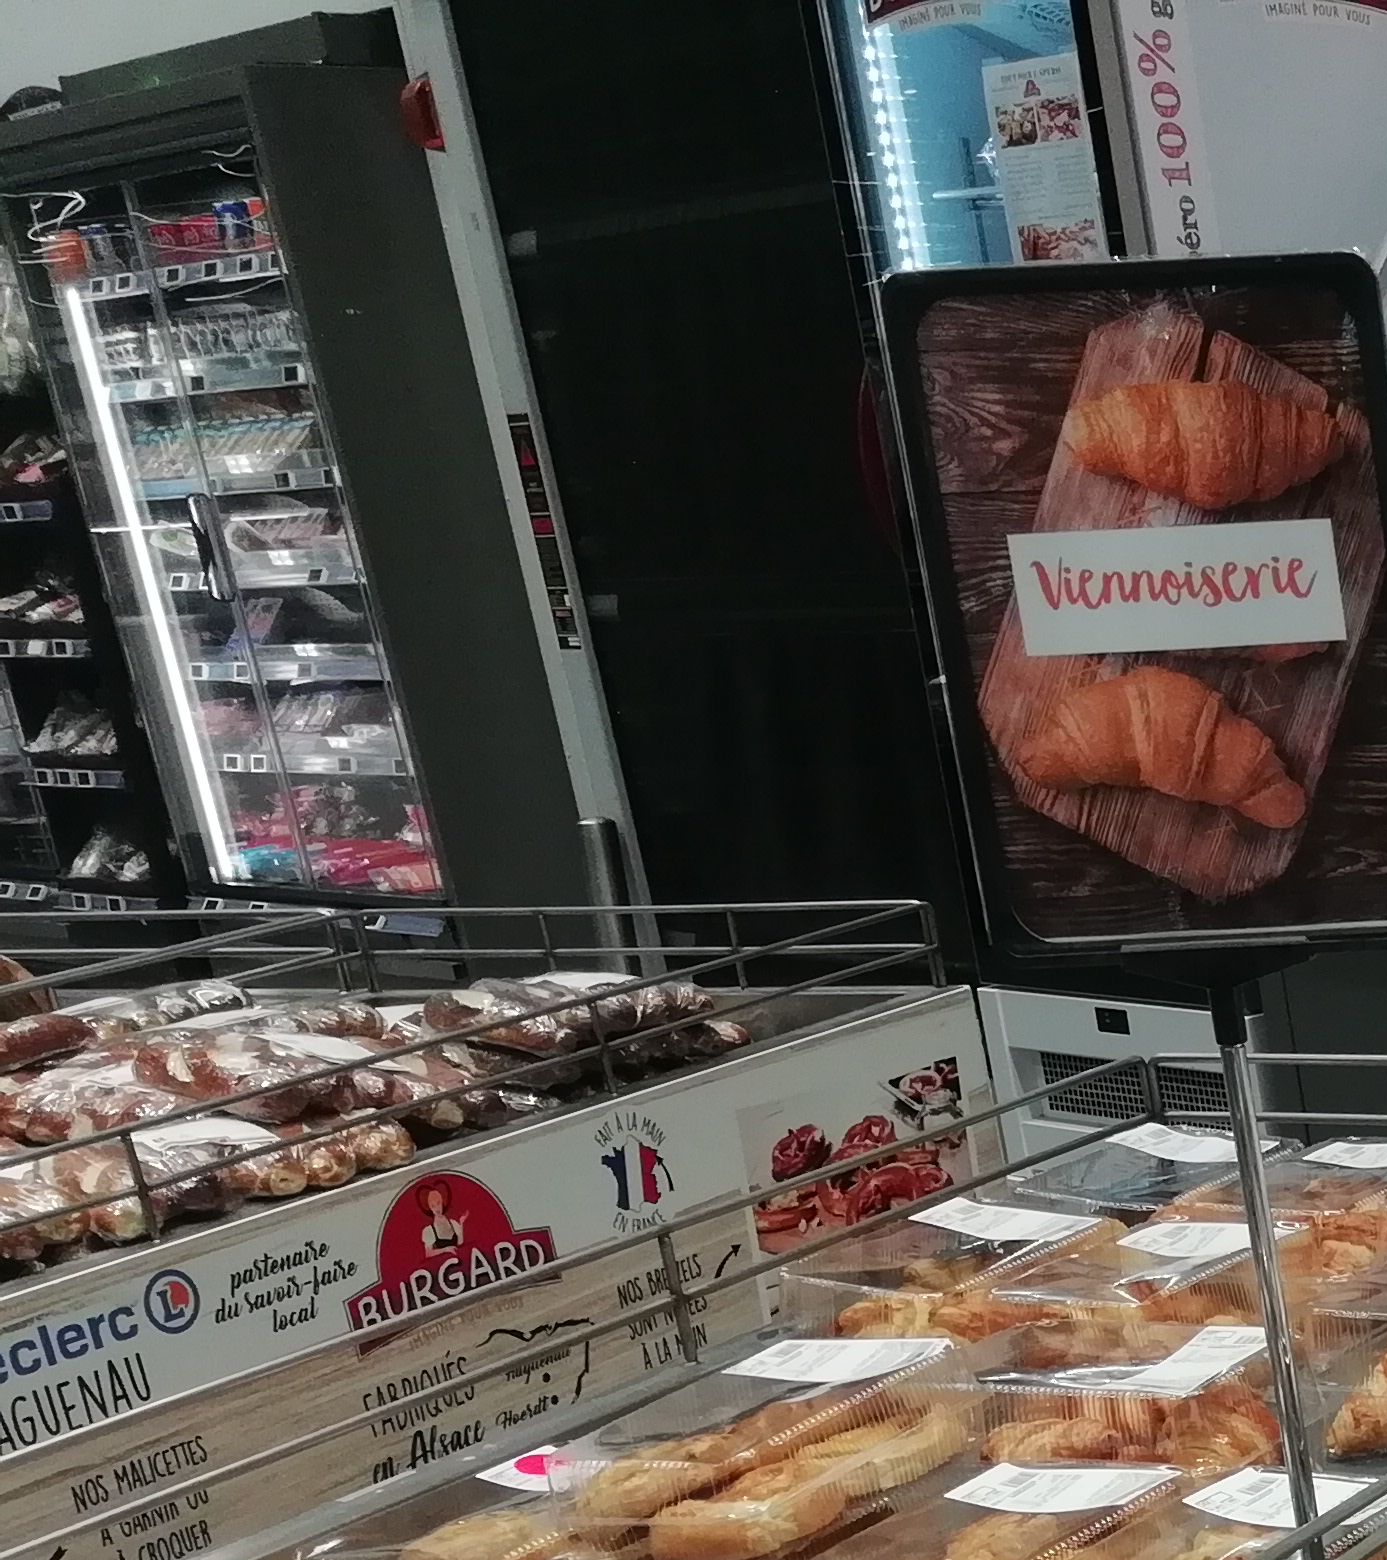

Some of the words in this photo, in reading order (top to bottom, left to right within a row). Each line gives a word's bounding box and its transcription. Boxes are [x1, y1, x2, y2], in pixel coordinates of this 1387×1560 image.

[1307, 4, 1340, 20] POUR
[1346, 8, 1371, 25] VOUS
[1133, 29, 1195, 188] 100%
[1030, 555, 1318, 615] Viennoiserie
[594, 1123, 612, 1147] FAIT
[616, 1112, 623, 1131] À
[626, 1112, 637, 1129] LA
[640, 1117, 666, 1147] MAIN
[613, 1212, 627, 1233] EN
[632, 1208, 667, 1233] FRANCE
[228, 1239, 331, 1291] partenaire
[357, 1239, 545, 1329] BURGARD
[214, 1299, 242, 1324] du
[244, 1260, 359, 1315] savoir-faire
[617, 1277, 644, 1309] NOS
[272, 1296, 319, 1332] local
[655, 1336, 672, 1366] LA
[496, 1395, 549, 1430] Hoerdt
[407, 1420, 485, 1470] Alsace
[71, 1474, 109, 1514] NOS
[113, 1435, 208, 1495] MALICETTES
